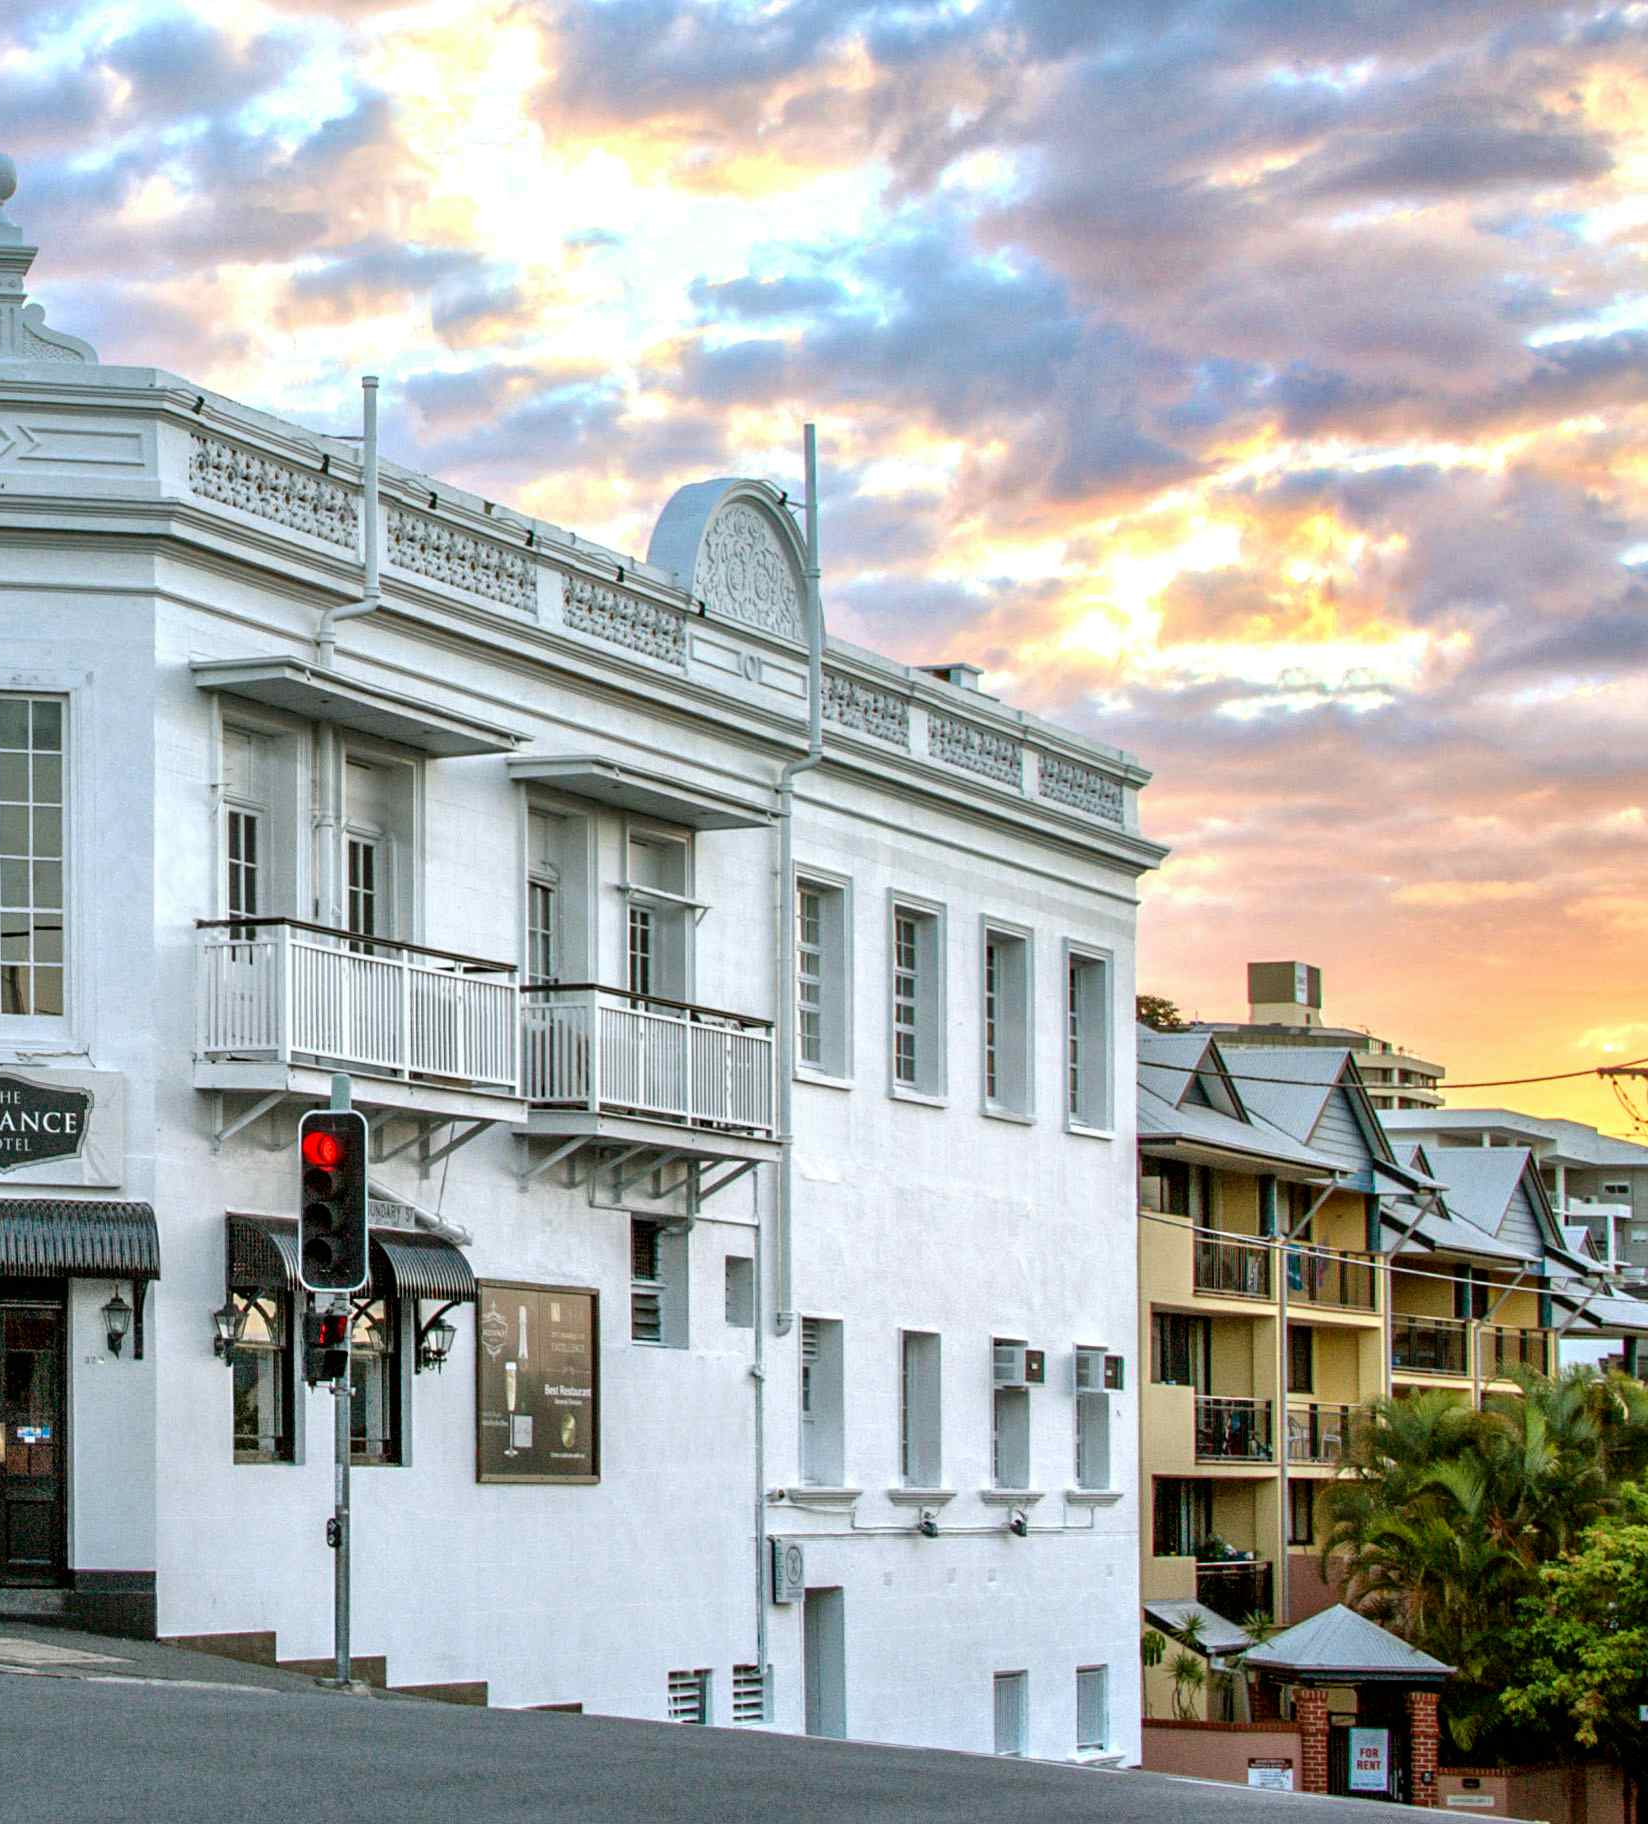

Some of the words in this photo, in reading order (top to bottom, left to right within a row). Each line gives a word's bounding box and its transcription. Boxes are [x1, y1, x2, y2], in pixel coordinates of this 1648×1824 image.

[368, 1202, 401, 1219] UNDARY
[544, 1383, 558, 1395] Best
[1360, 1747, 1378, 1757] FOR
[1357, 1760, 1381, 1770] RENT
